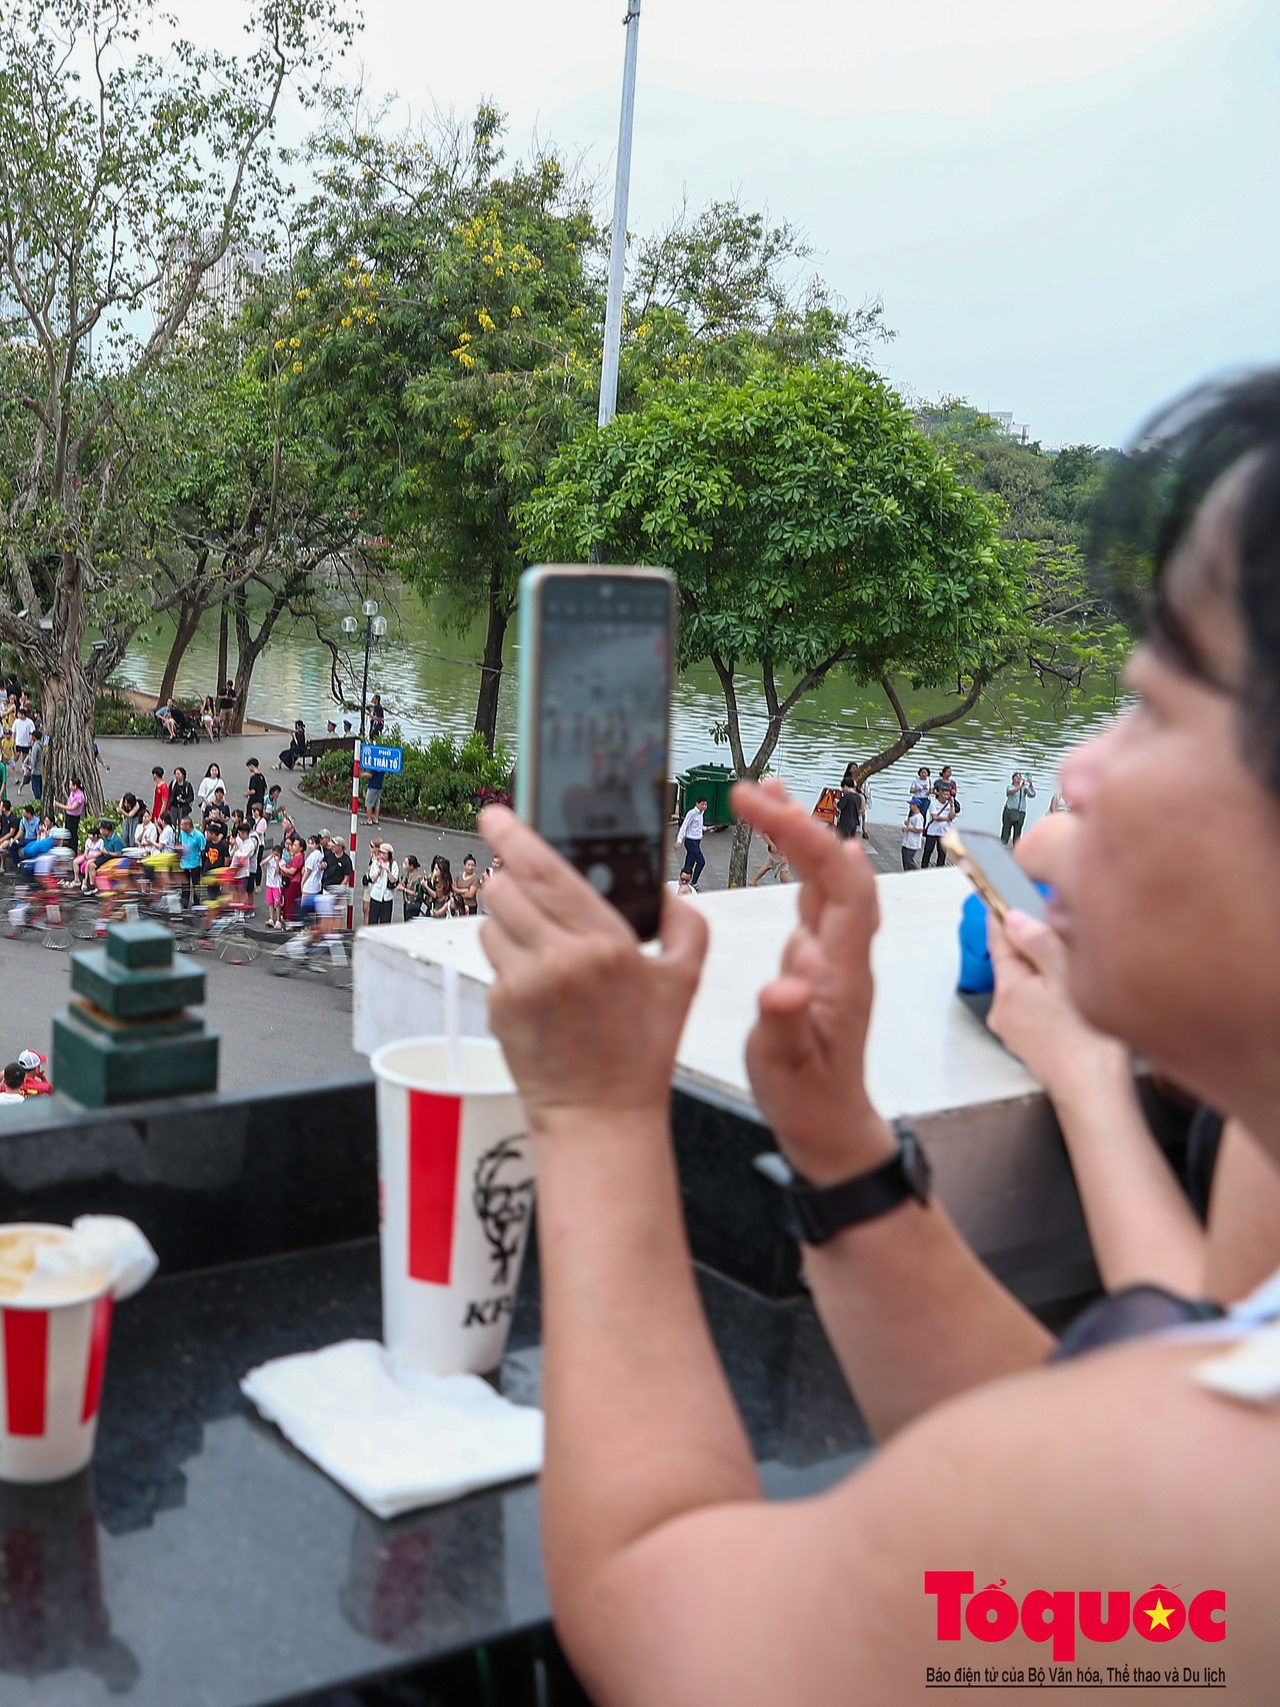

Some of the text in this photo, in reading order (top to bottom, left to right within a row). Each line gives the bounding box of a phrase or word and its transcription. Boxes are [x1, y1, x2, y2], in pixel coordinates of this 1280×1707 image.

[378, 748, 392, 756] PHỐ
[364, 755, 399, 770] LÊ THÁI TỔ
